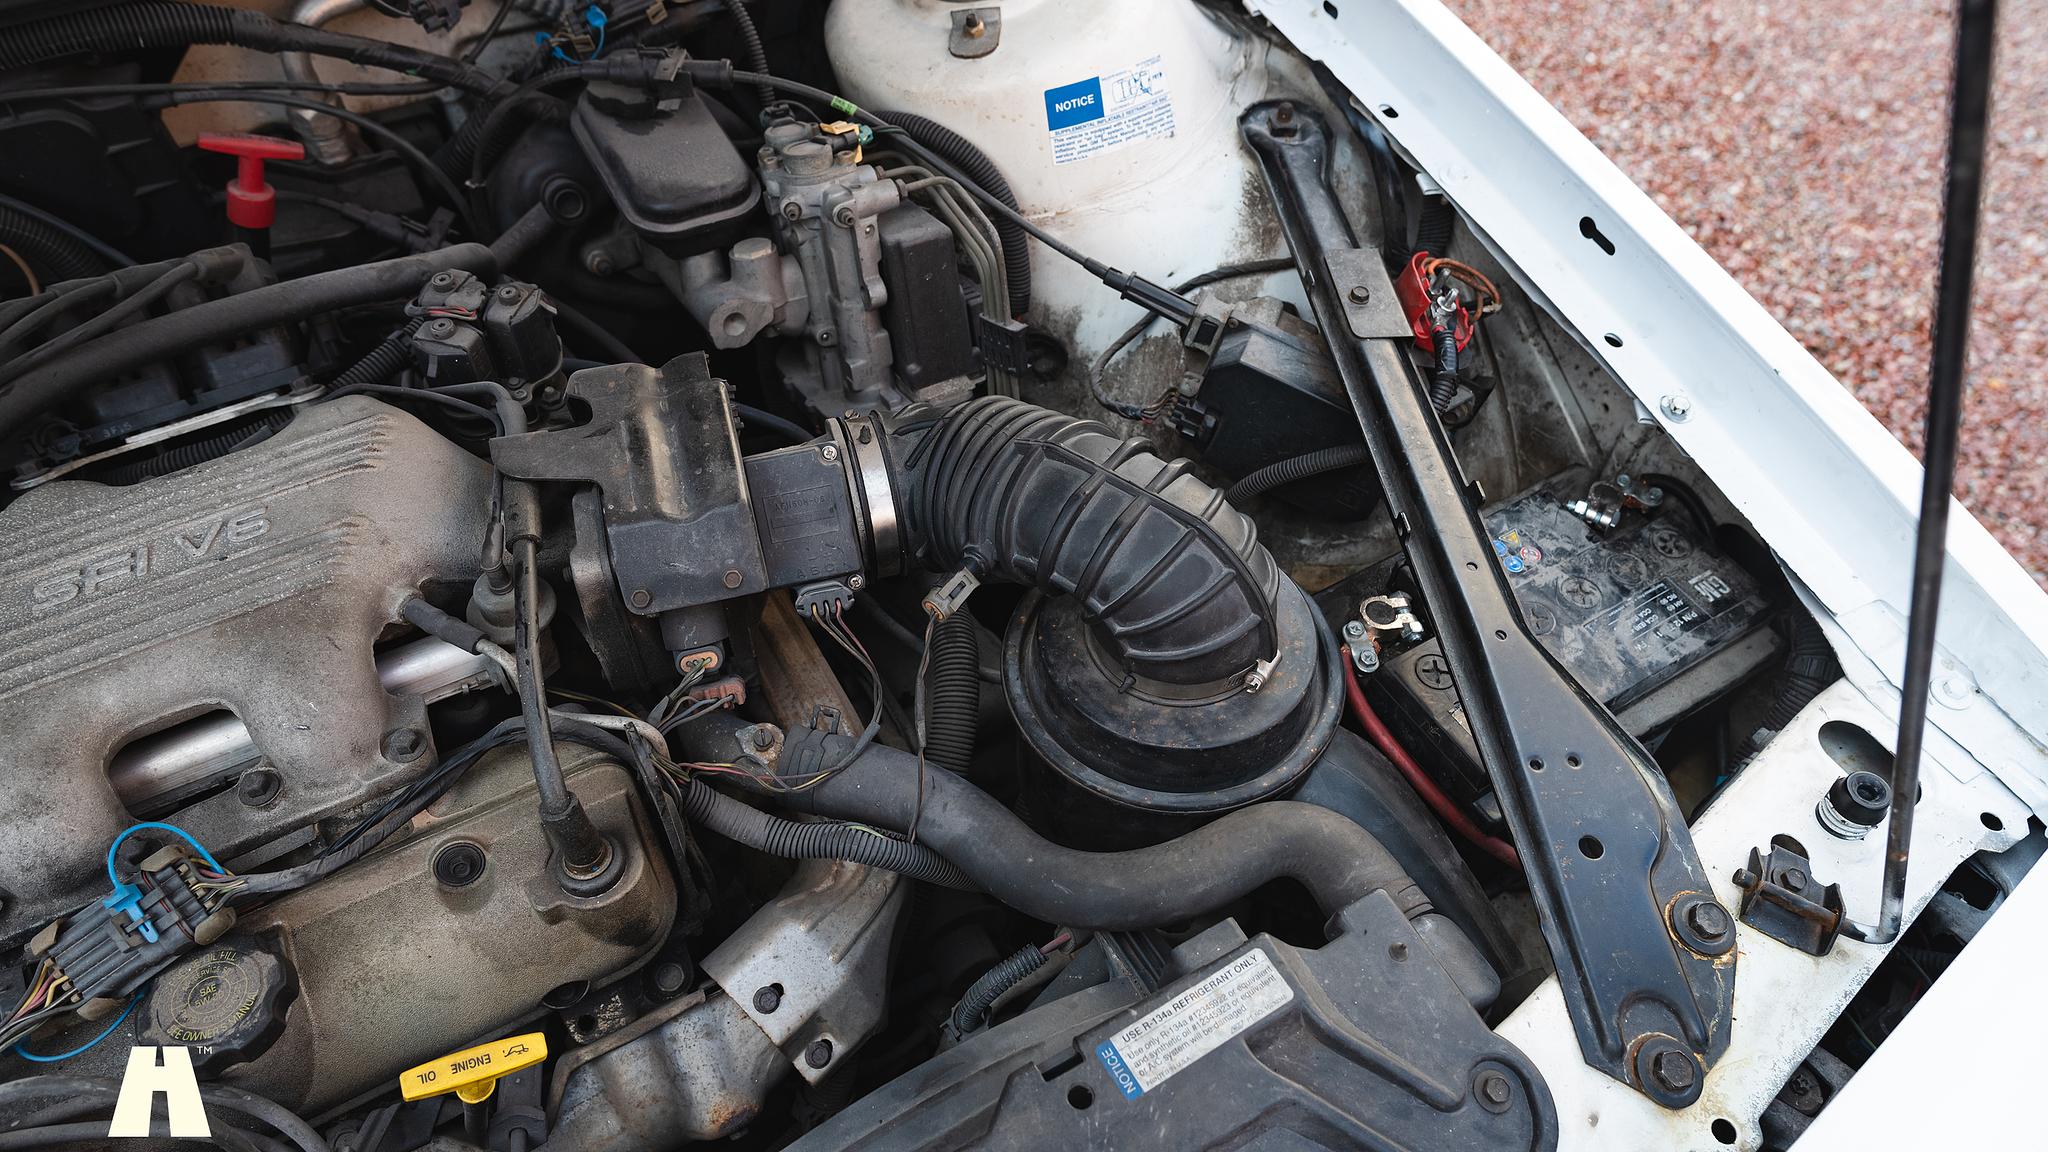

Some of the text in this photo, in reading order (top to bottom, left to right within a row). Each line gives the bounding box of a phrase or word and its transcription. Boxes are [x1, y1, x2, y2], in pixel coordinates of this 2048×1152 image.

[1055, 94, 1095, 113] NOTICE
[32, 506, 271, 612] SFI V6
[1694, 574, 1731, 603] GM
[200, 984, 217, 996] SAE
[1121, 954, 1259, 1043] USE R-134a REFRIGERANT ONLY
[1127, 1046, 1144, 1059] Use
[1143, 1035, 1161, 1050] only
[1159, 1018, 1188, 1039] R-134a
[1227, 988, 1237, 997] or
[1235, 965, 1273, 992] equivalent
[1132, 1054, 1149, 1068] and
[1147, 1034, 1182, 1059] synthetic
[1181, 1027, 1191, 1037] oil
[1231, 997, 1240, 1006] or
[1239, 974, 1277, 1002] equivalent
[416, 1053, 491, 1084] ENGINE OIL
[1101, 1047, 1136, 1094] NOTICE
[1138, 1067, 1147, 1076] or
[1162, 1040, 1190, 1062] system
[1189, 1031, 1203, 1043] will
[1202, 1025, 1213, 1036] be
